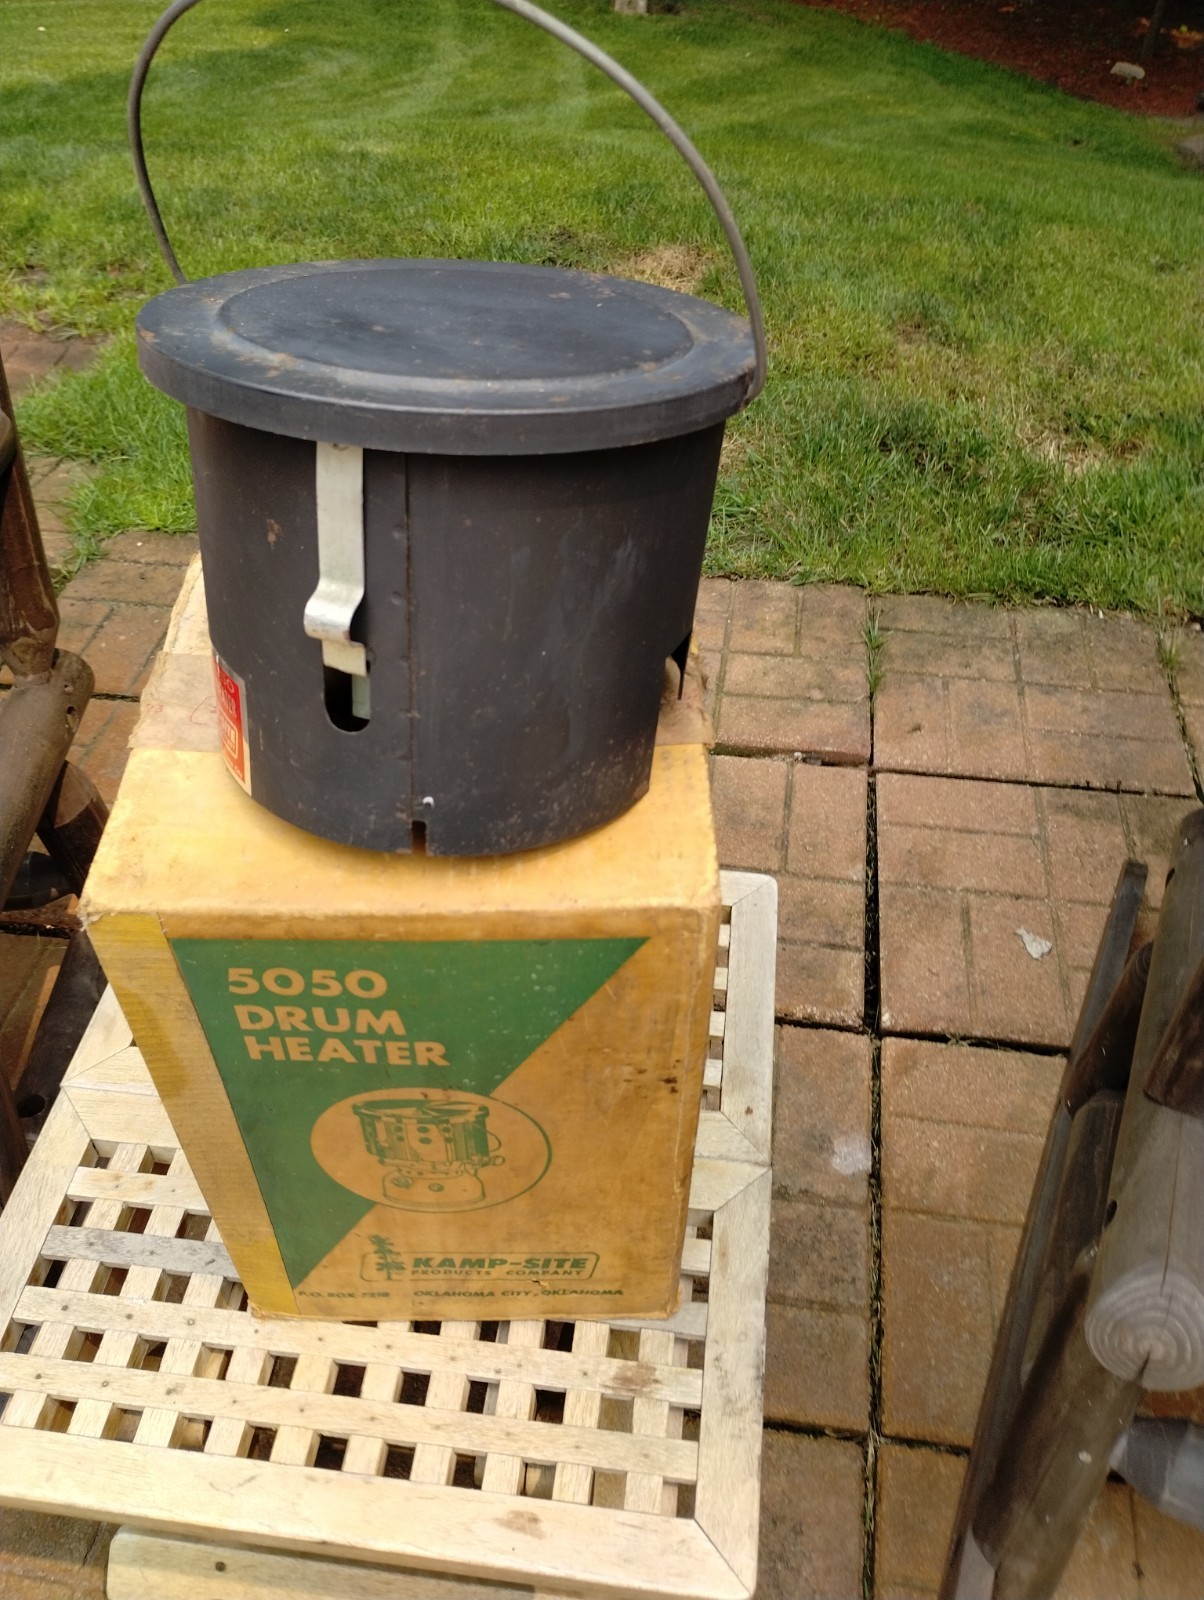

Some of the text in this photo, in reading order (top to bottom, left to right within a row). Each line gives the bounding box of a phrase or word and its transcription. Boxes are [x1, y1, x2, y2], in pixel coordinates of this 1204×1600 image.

[228, 967, 388, 999] 5050
[234, 1004, 407, 1036] DRUM
[243, 1036, 451, 1067] HEATER
[412, 1257, 589, 1270] KAMP-SITE
[501, 1289, 539, 1297] CITY,
[541, 1288, 624, 1296] OKLAHOMA
